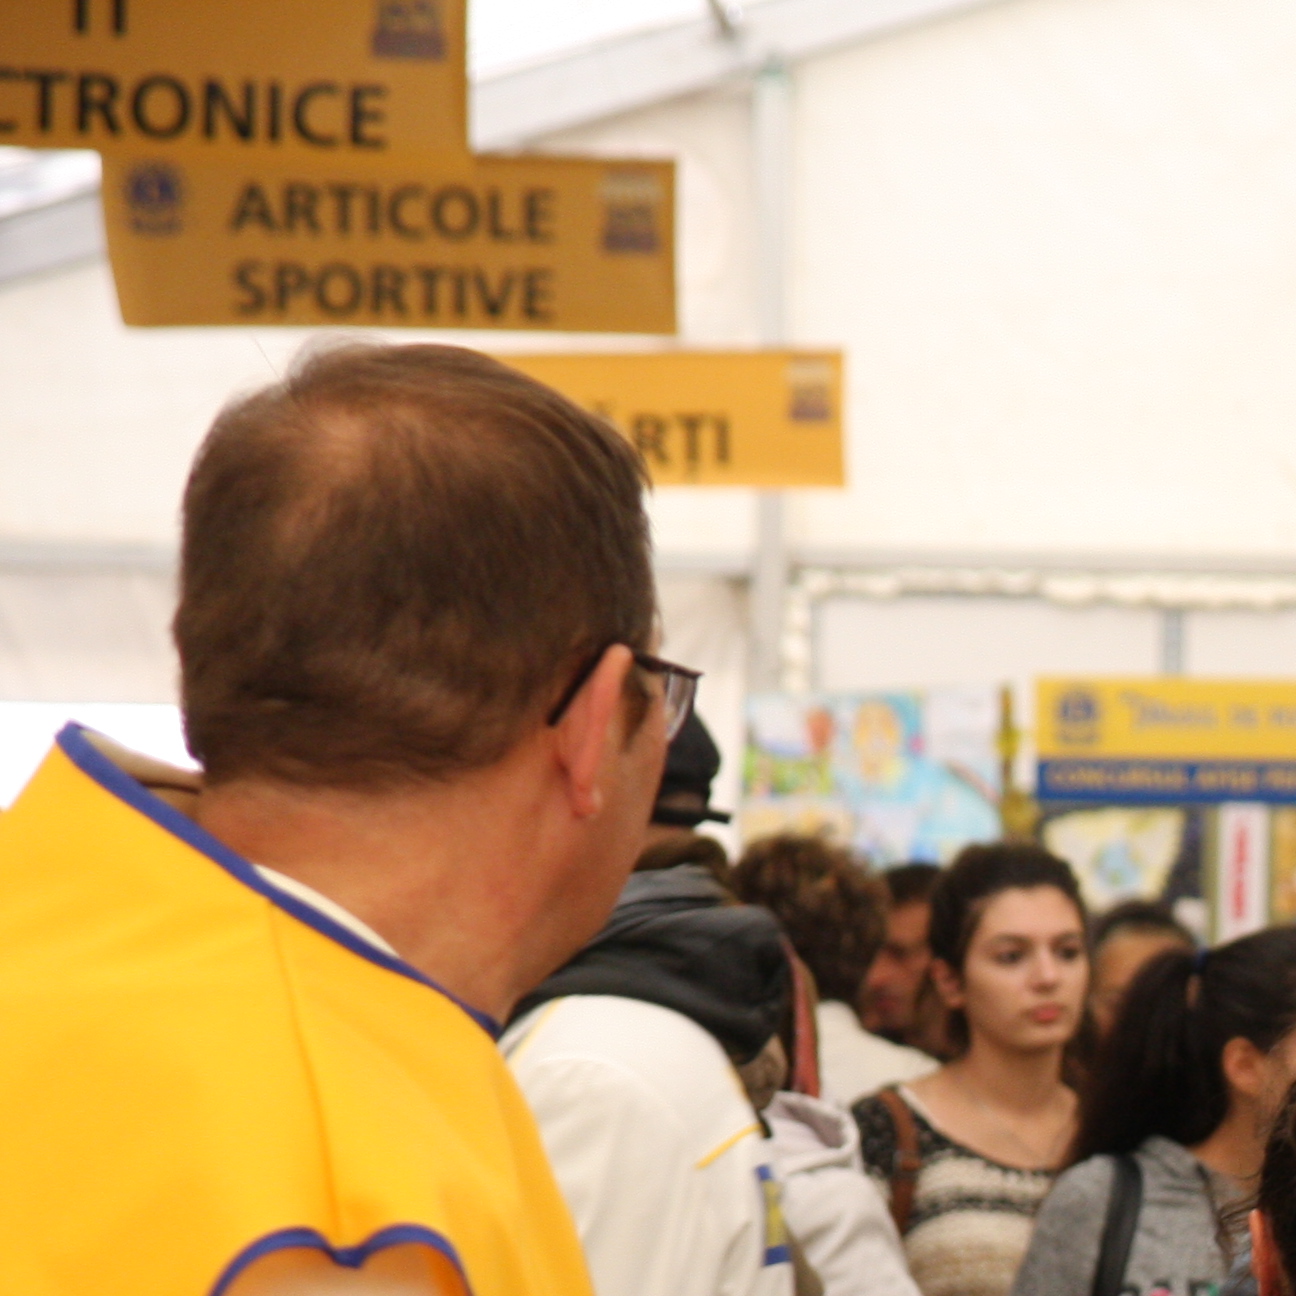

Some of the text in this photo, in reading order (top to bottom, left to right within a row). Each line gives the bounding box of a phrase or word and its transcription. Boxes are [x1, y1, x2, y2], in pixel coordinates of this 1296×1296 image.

[230, 183, 555, 245] ARTICOLE
[233, 260, 555, 323] SPORTIVE
[606, 404, 732, 480] RȚI
